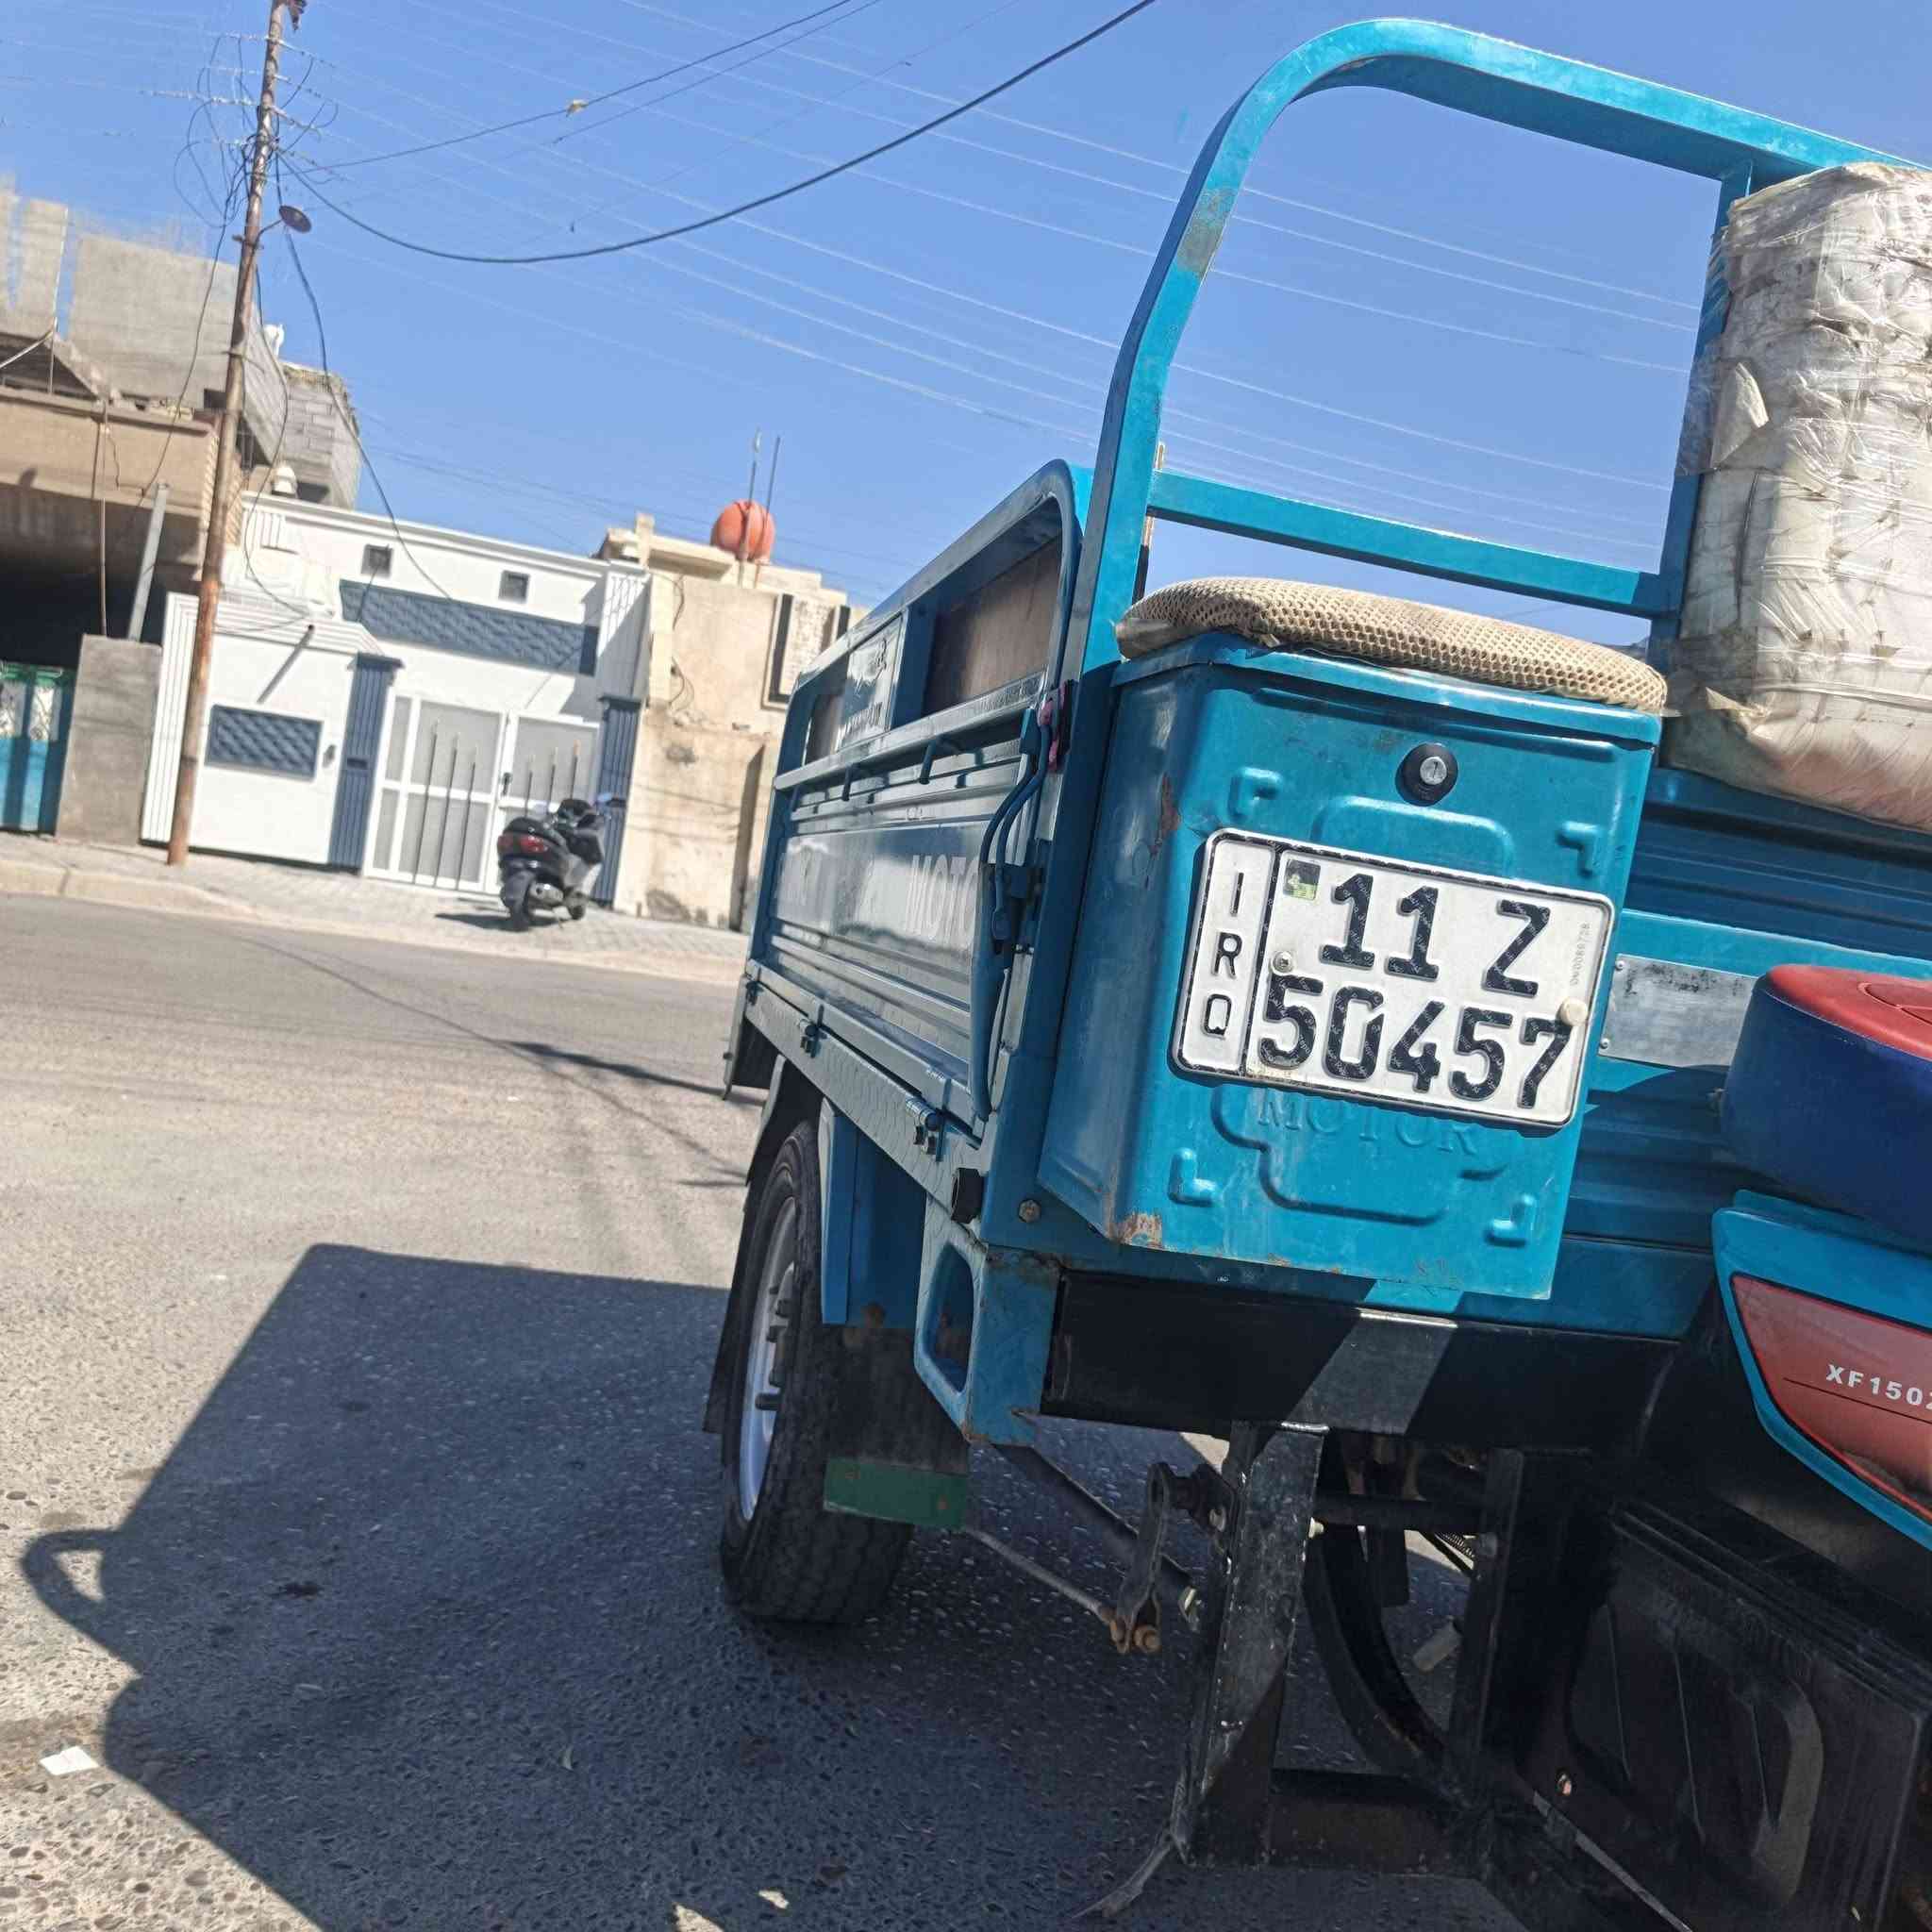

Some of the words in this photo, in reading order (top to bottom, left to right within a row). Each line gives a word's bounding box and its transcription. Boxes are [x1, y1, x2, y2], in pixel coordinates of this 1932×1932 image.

[1320, 873, 1440, 982] 11
[1482, 898, 1551, 998] Z
[1257, 974, 1574, 1109] 50457
